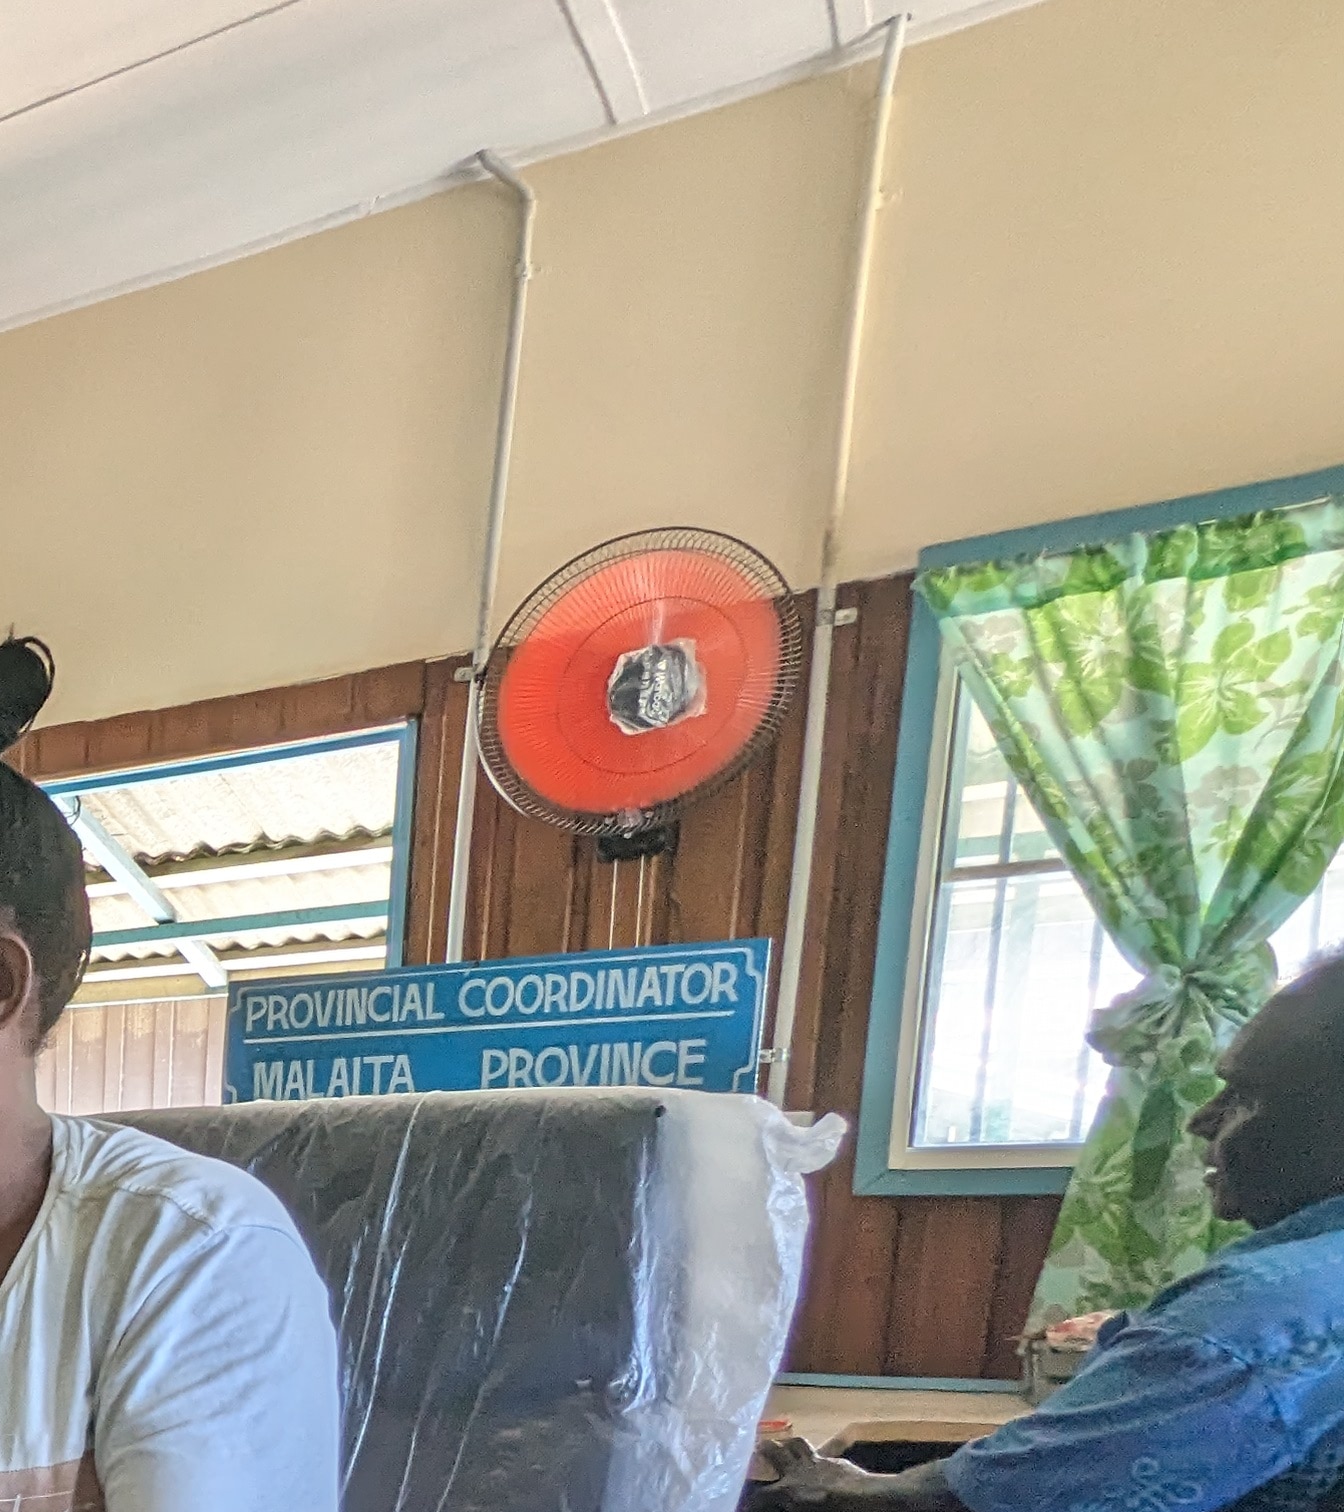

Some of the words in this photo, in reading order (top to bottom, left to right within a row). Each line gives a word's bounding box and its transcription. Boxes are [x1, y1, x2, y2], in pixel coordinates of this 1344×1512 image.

[244, 983, 446, 1033] PROVINCIAL
[457, 961, 740, 1018] COORDINATOR
[253, 1055, 416, 1100] MALAITA
[481, 1039, 708, 1090] PROVINCE
